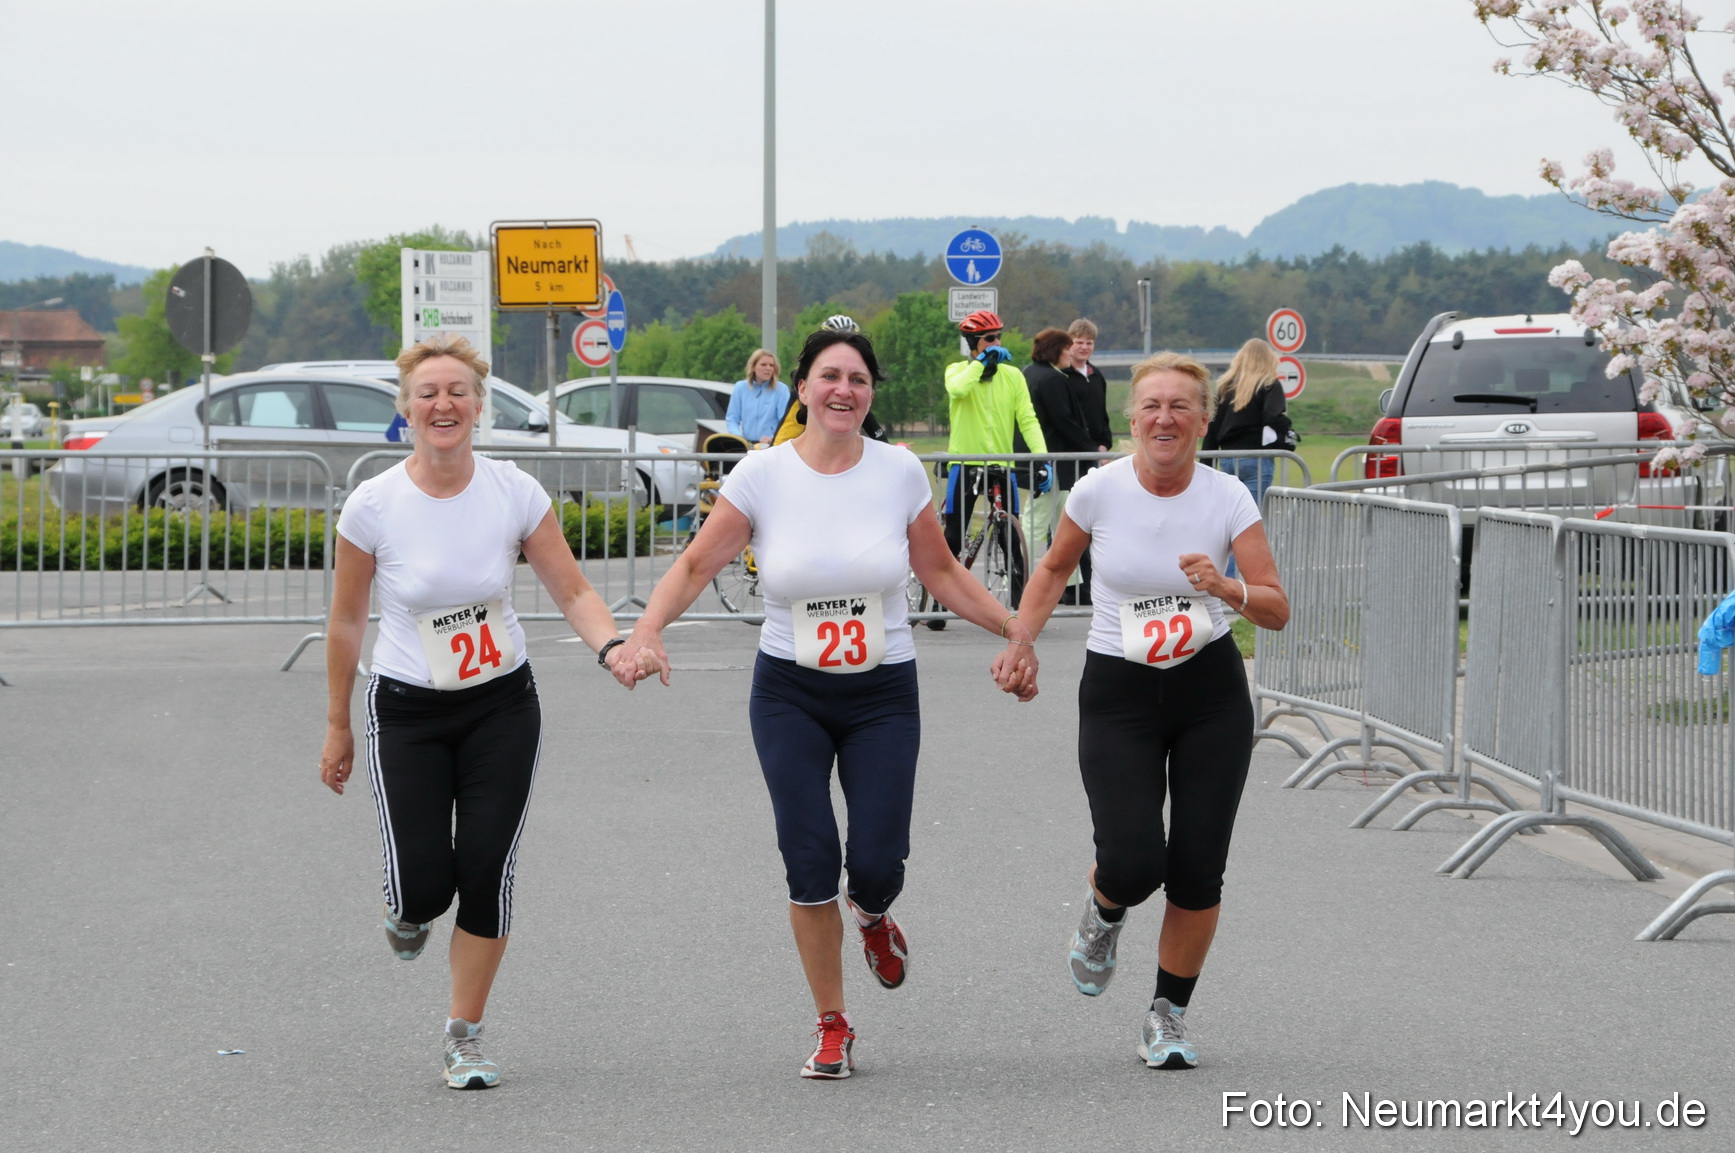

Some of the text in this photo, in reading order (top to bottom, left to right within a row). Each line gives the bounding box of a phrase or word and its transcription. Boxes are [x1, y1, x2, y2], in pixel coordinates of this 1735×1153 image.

[533, 239, 562, 249] Nach
[506, 254, 589, 274] Neumarkt
[535, 281, 564, 292] 5 km
[422, 308, 440, 328] SHB
[1277, 322, 1297, 341] 60
[1506, 425, 1528, 434] KIA
[806, 599, 847, 611] MEYER
[1133, 595, 1174, 612] MEYER
[1134, 605, 1175, 619] WERBUNG
[432, 608, 472, 629] MEYER
[807, 608, 849, 618] WERBUNG
[434, 617, 475, 635] WERBUNG
[817, 619, 867, 667] 23
[1143, 614, 1195, 664] 22
[450, 623, 502, 680] 24
